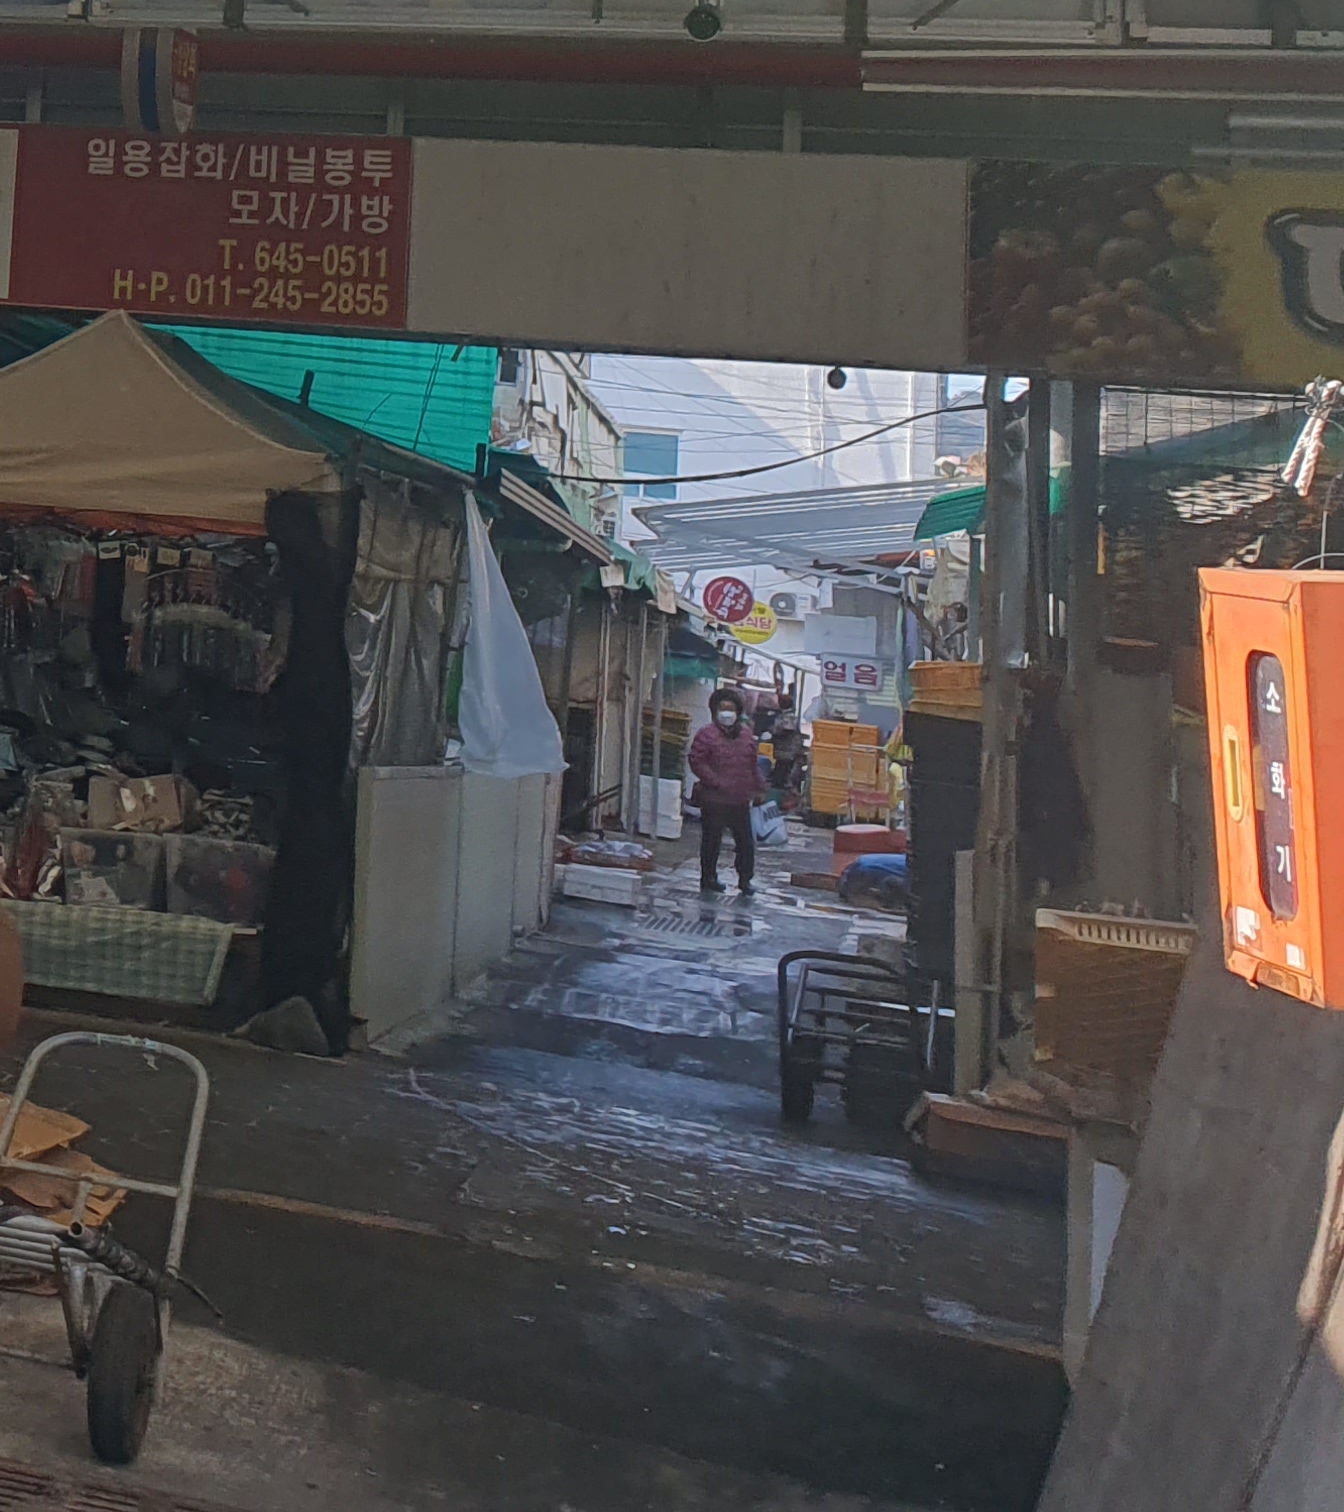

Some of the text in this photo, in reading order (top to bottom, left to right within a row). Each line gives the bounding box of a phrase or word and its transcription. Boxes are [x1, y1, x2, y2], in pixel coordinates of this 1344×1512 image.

[86, 138, 395, 187] 일용잡화/비닐봉투
[228, 190, 393, 235] 모자/가방
[254, 240, 388, 277] 645-0511
[185, 272, 389, 317] 011-245-2855
[823, 660, 878, 686] 얼음
[1264, 681, 1292, 882] 소화기
